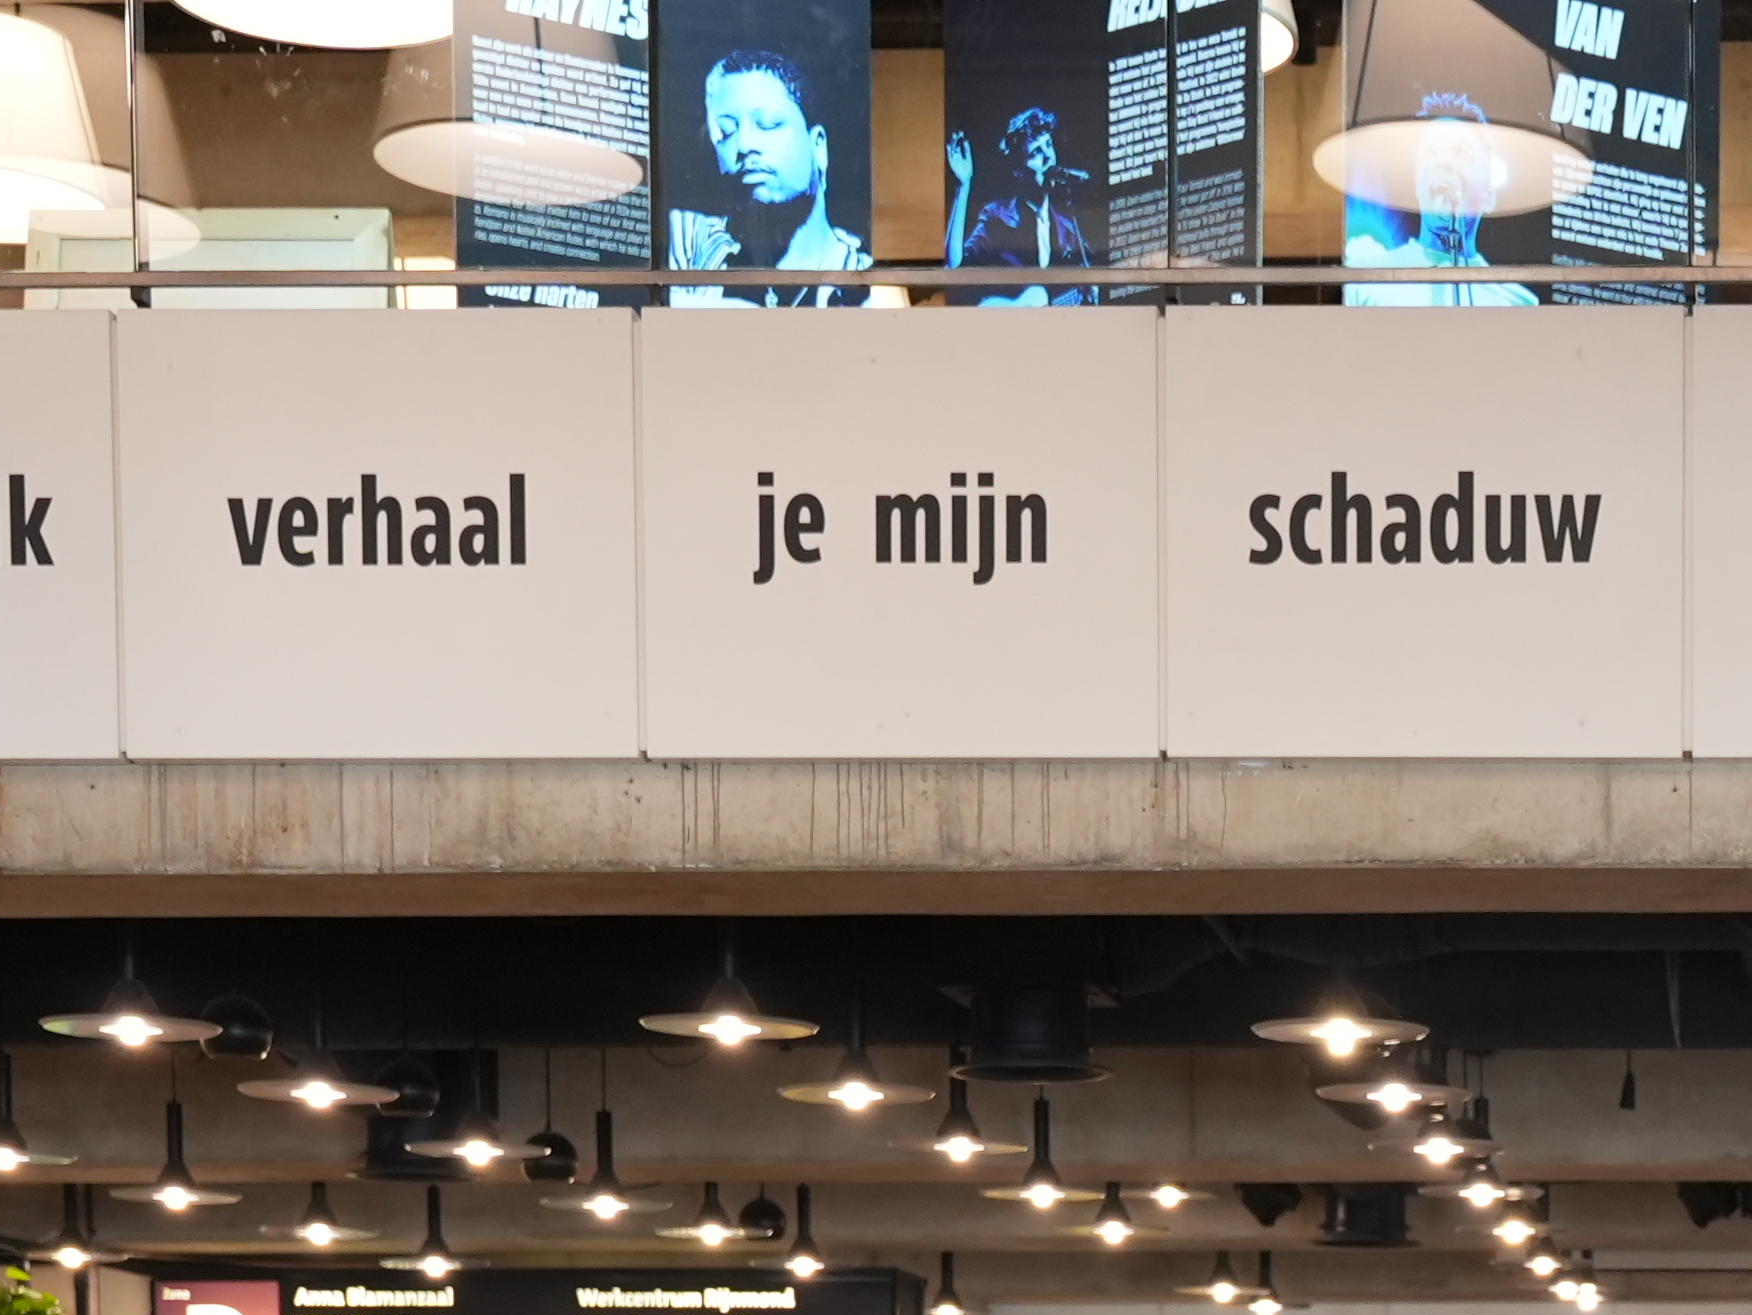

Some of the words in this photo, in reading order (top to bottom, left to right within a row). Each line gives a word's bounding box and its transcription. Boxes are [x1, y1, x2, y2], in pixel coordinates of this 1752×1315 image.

[1555, 0, 1625, 60] VAN
[1550, 73, 1617, 133] DER
[1624, 90, 1687, 149] VEN
[228, 474, 526, 566] verhaal
[753, 472, 825, 584] je
[876, 473, 1046, 585] mijn
[1249, 471, 1601, 564] schaduw
[294, 1287, 345, 1306] Anna
[577, 1288, 702, 1307] Werkcentrum
